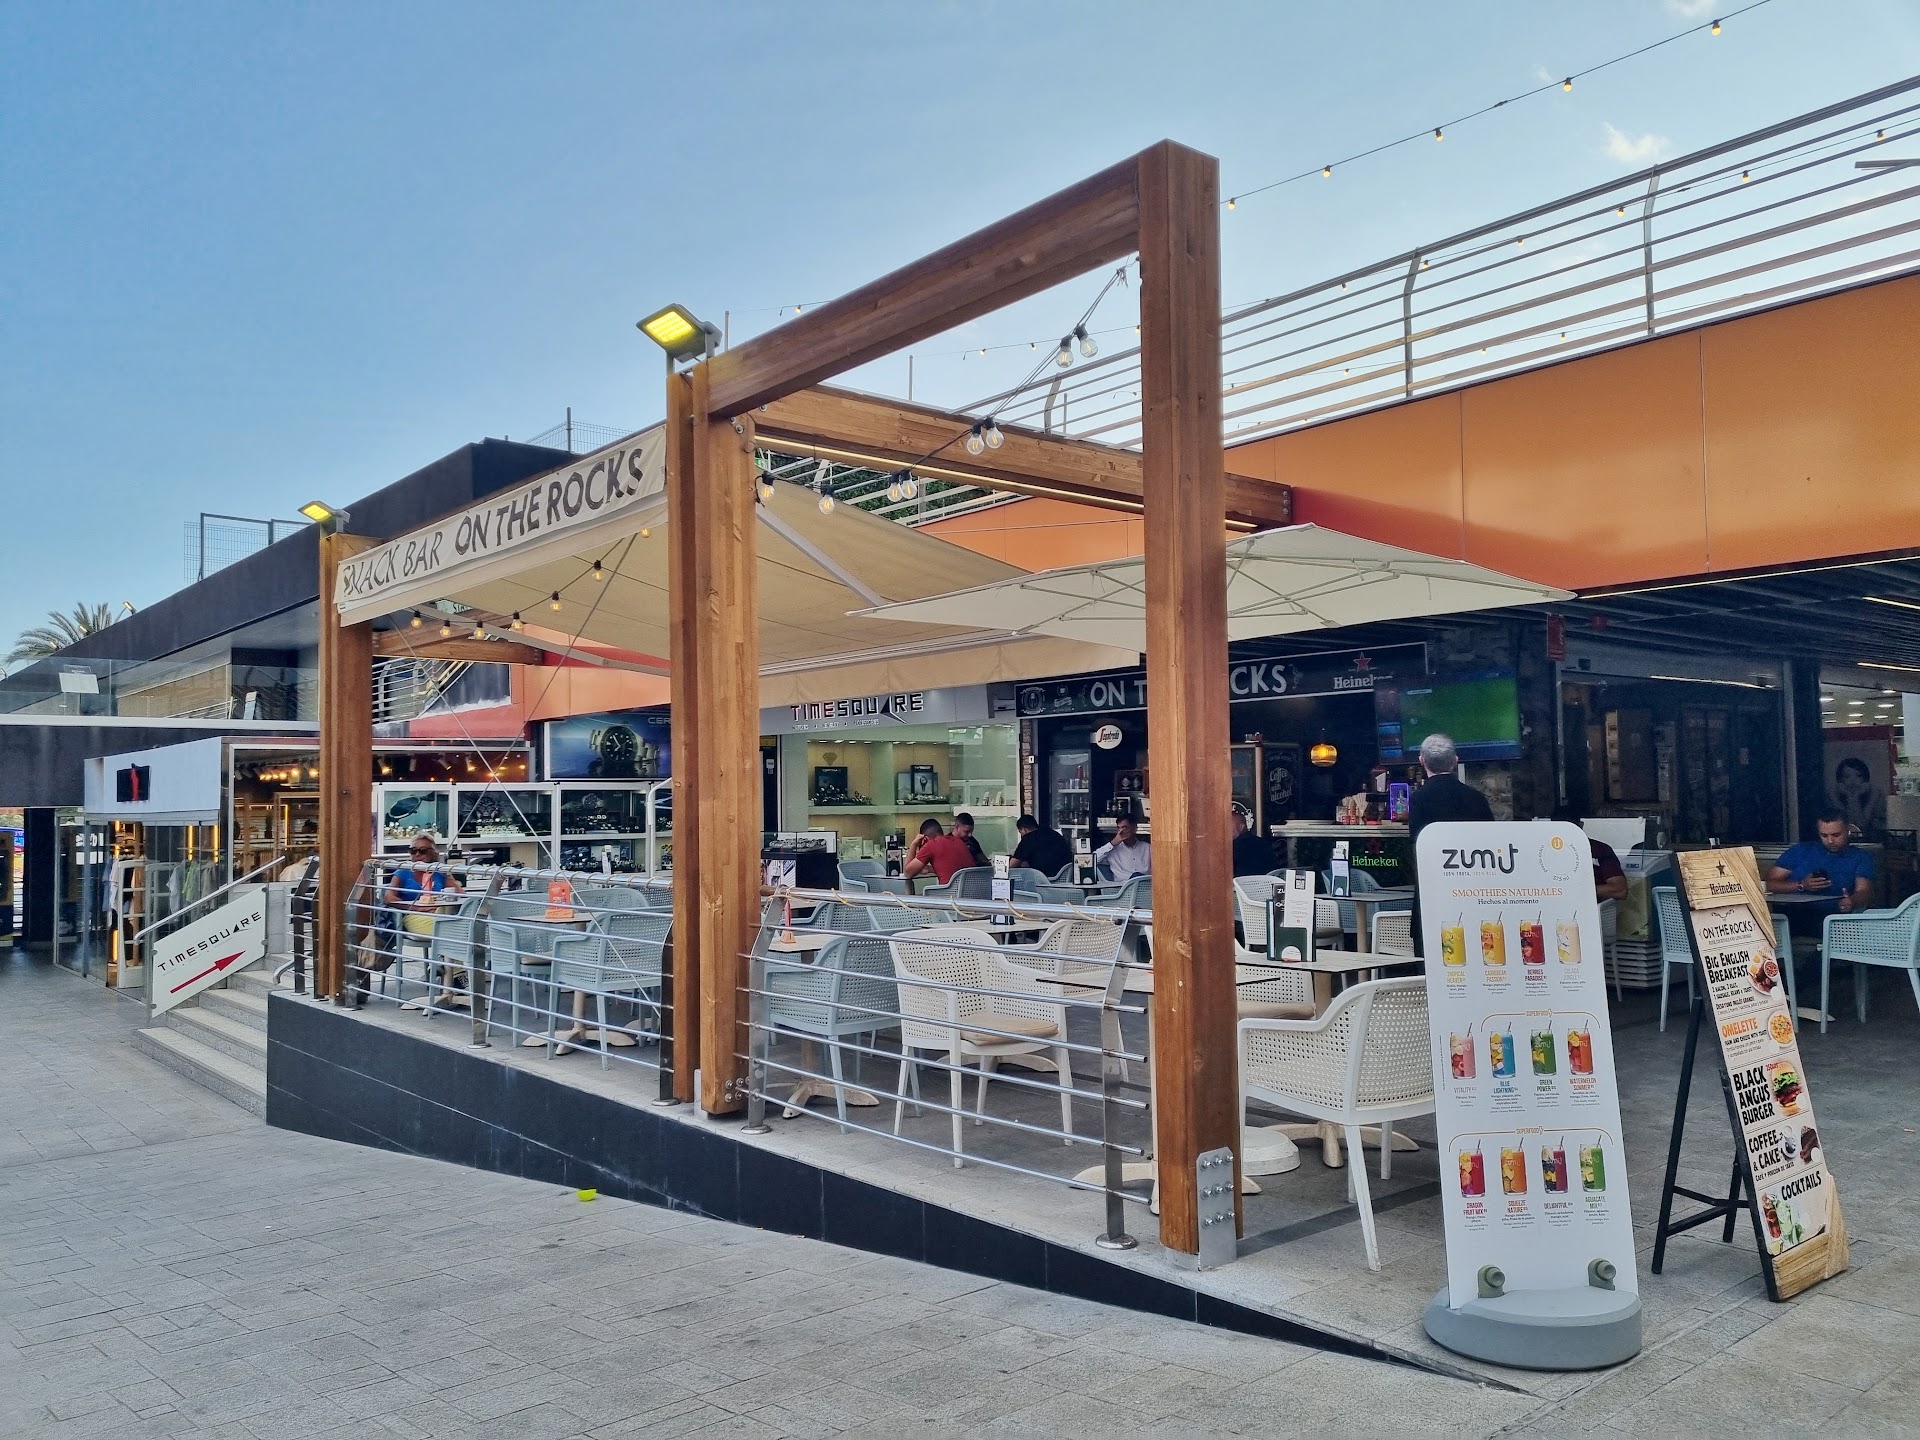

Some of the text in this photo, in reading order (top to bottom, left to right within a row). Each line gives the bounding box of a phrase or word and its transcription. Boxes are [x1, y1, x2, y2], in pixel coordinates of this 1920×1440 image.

[403, 531, 443, 577] BAR
[455, 510, 491, 555] ON
[496, 484, 543, 547] THE
[547, 448, 644, 525] ROCKS
[1090, 681, 1126, 707] ON
[1230, 663, 1288, 695] CKS
[1352, 855, 1399, 867] Heineken
[1452, 887, 1563, 897] SMOOTHIES NATURALES
[1709, 881, 1743, 895] Heineken
[1703, 920, 1753, 939] ON THE ROCKS
[1704, 950, 1750, 970] BIG ENGLISH
[1708, 964, 1749, 984] BREAKFAST
[1721, 1017, 1758, 1038] OMELETTE
[1732, 1065, 1767, 1091] BLACK
[1738, 1084, 1770, 1110] ANGUS
[1741, 1102, 1775, 1126] BURGER
[1748, 1129, 1779, 1154] COFFEE
[1752, 1147, 1781, 1172] & CAKE
[1781, 1170, 1822, 1201] COCKTAILS
